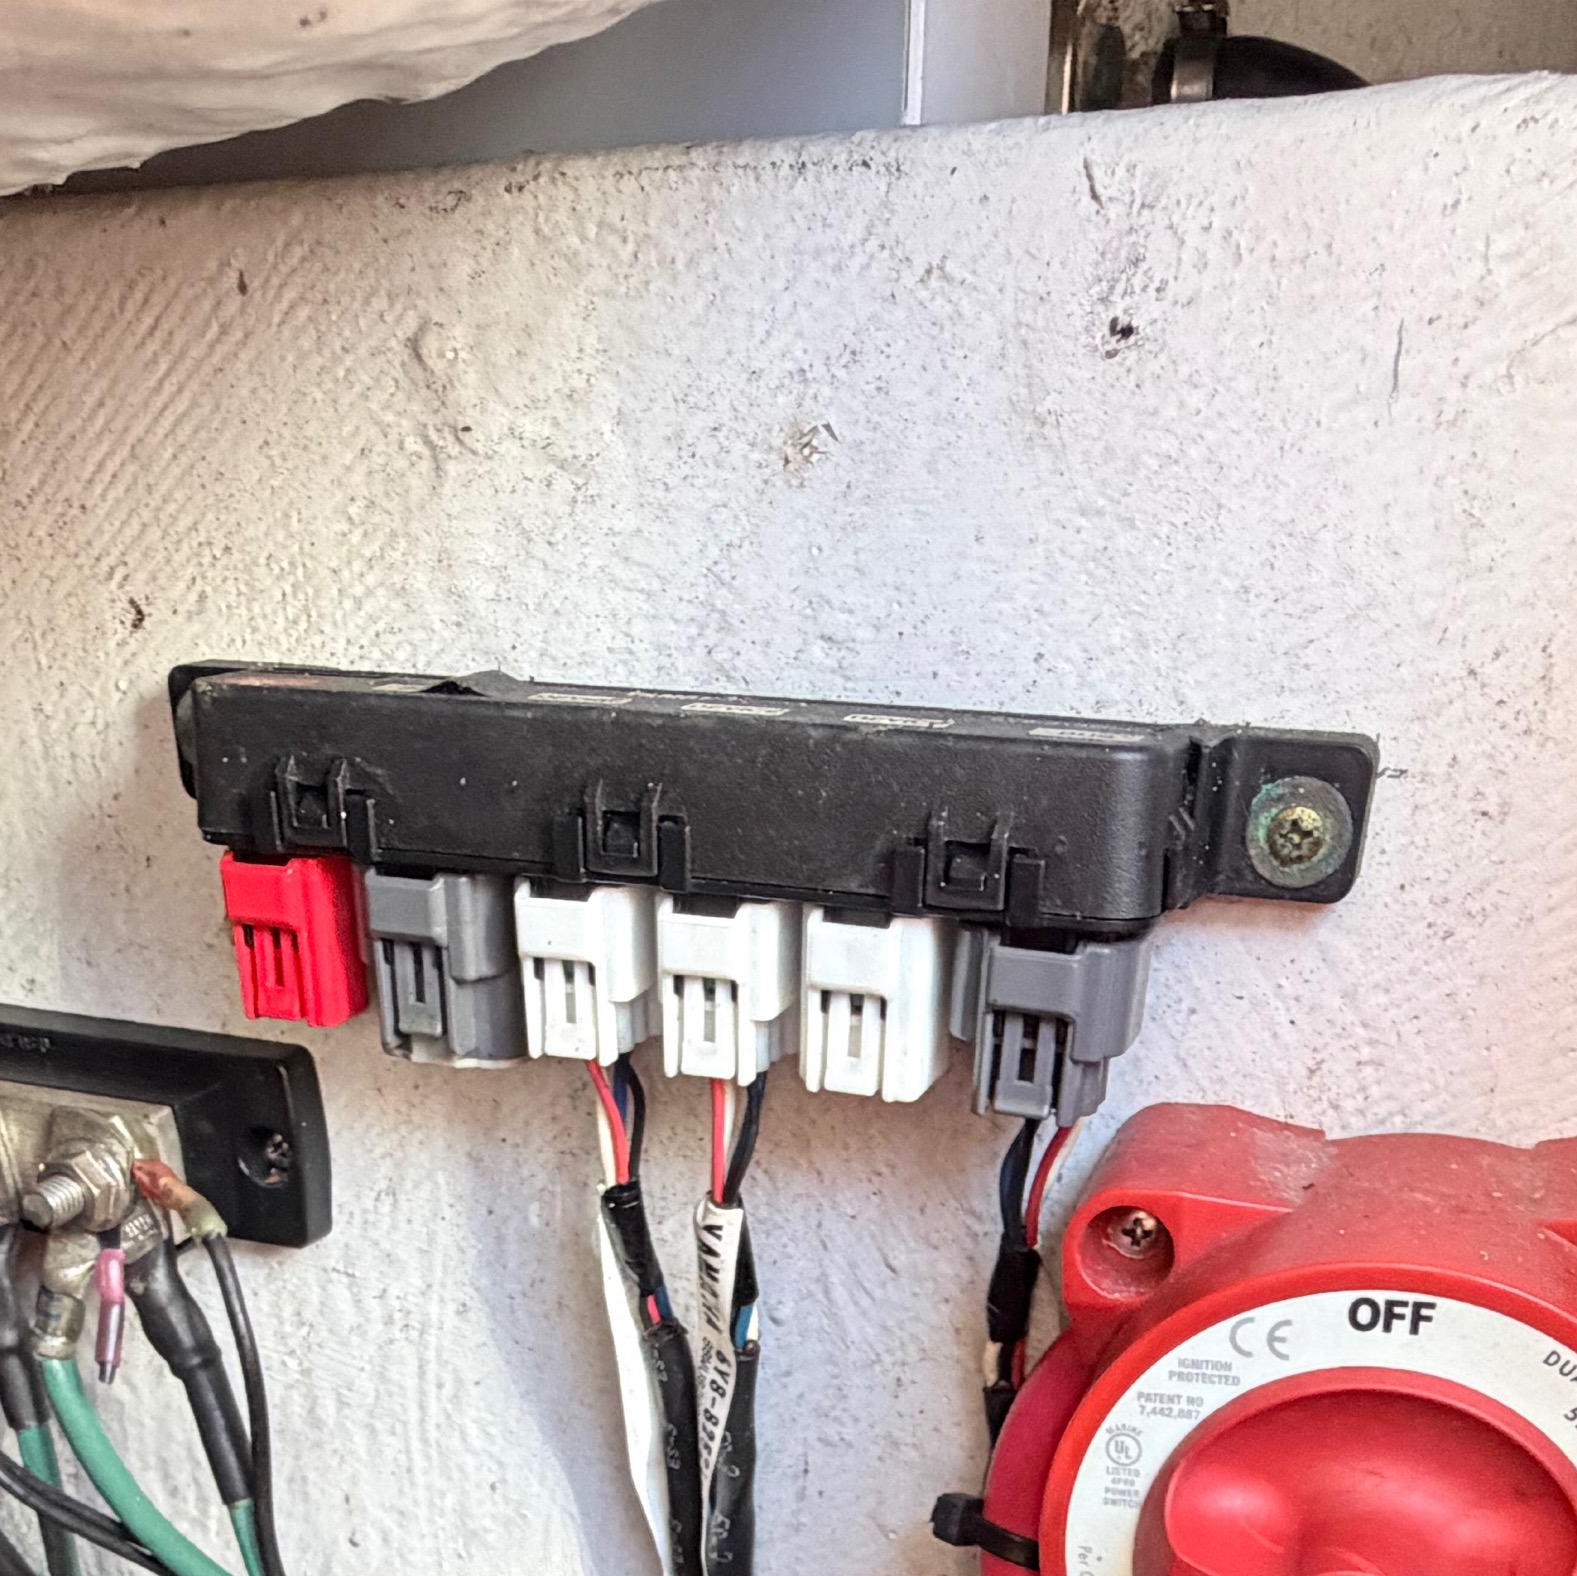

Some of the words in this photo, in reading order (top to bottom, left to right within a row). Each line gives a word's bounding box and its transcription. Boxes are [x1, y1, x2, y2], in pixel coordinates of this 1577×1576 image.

[1348, 1297, 1437, 1336] OFF
[1228, 1317, 1293, 1361] CE
[1177, 1357, 1233, 1372] IGNITION
[1168, 1370, 1241, 1386] PROTECTED
[1137, 1391, 1182, 1406] PATENT
[1114, 1440, 1132, 1460] UL
